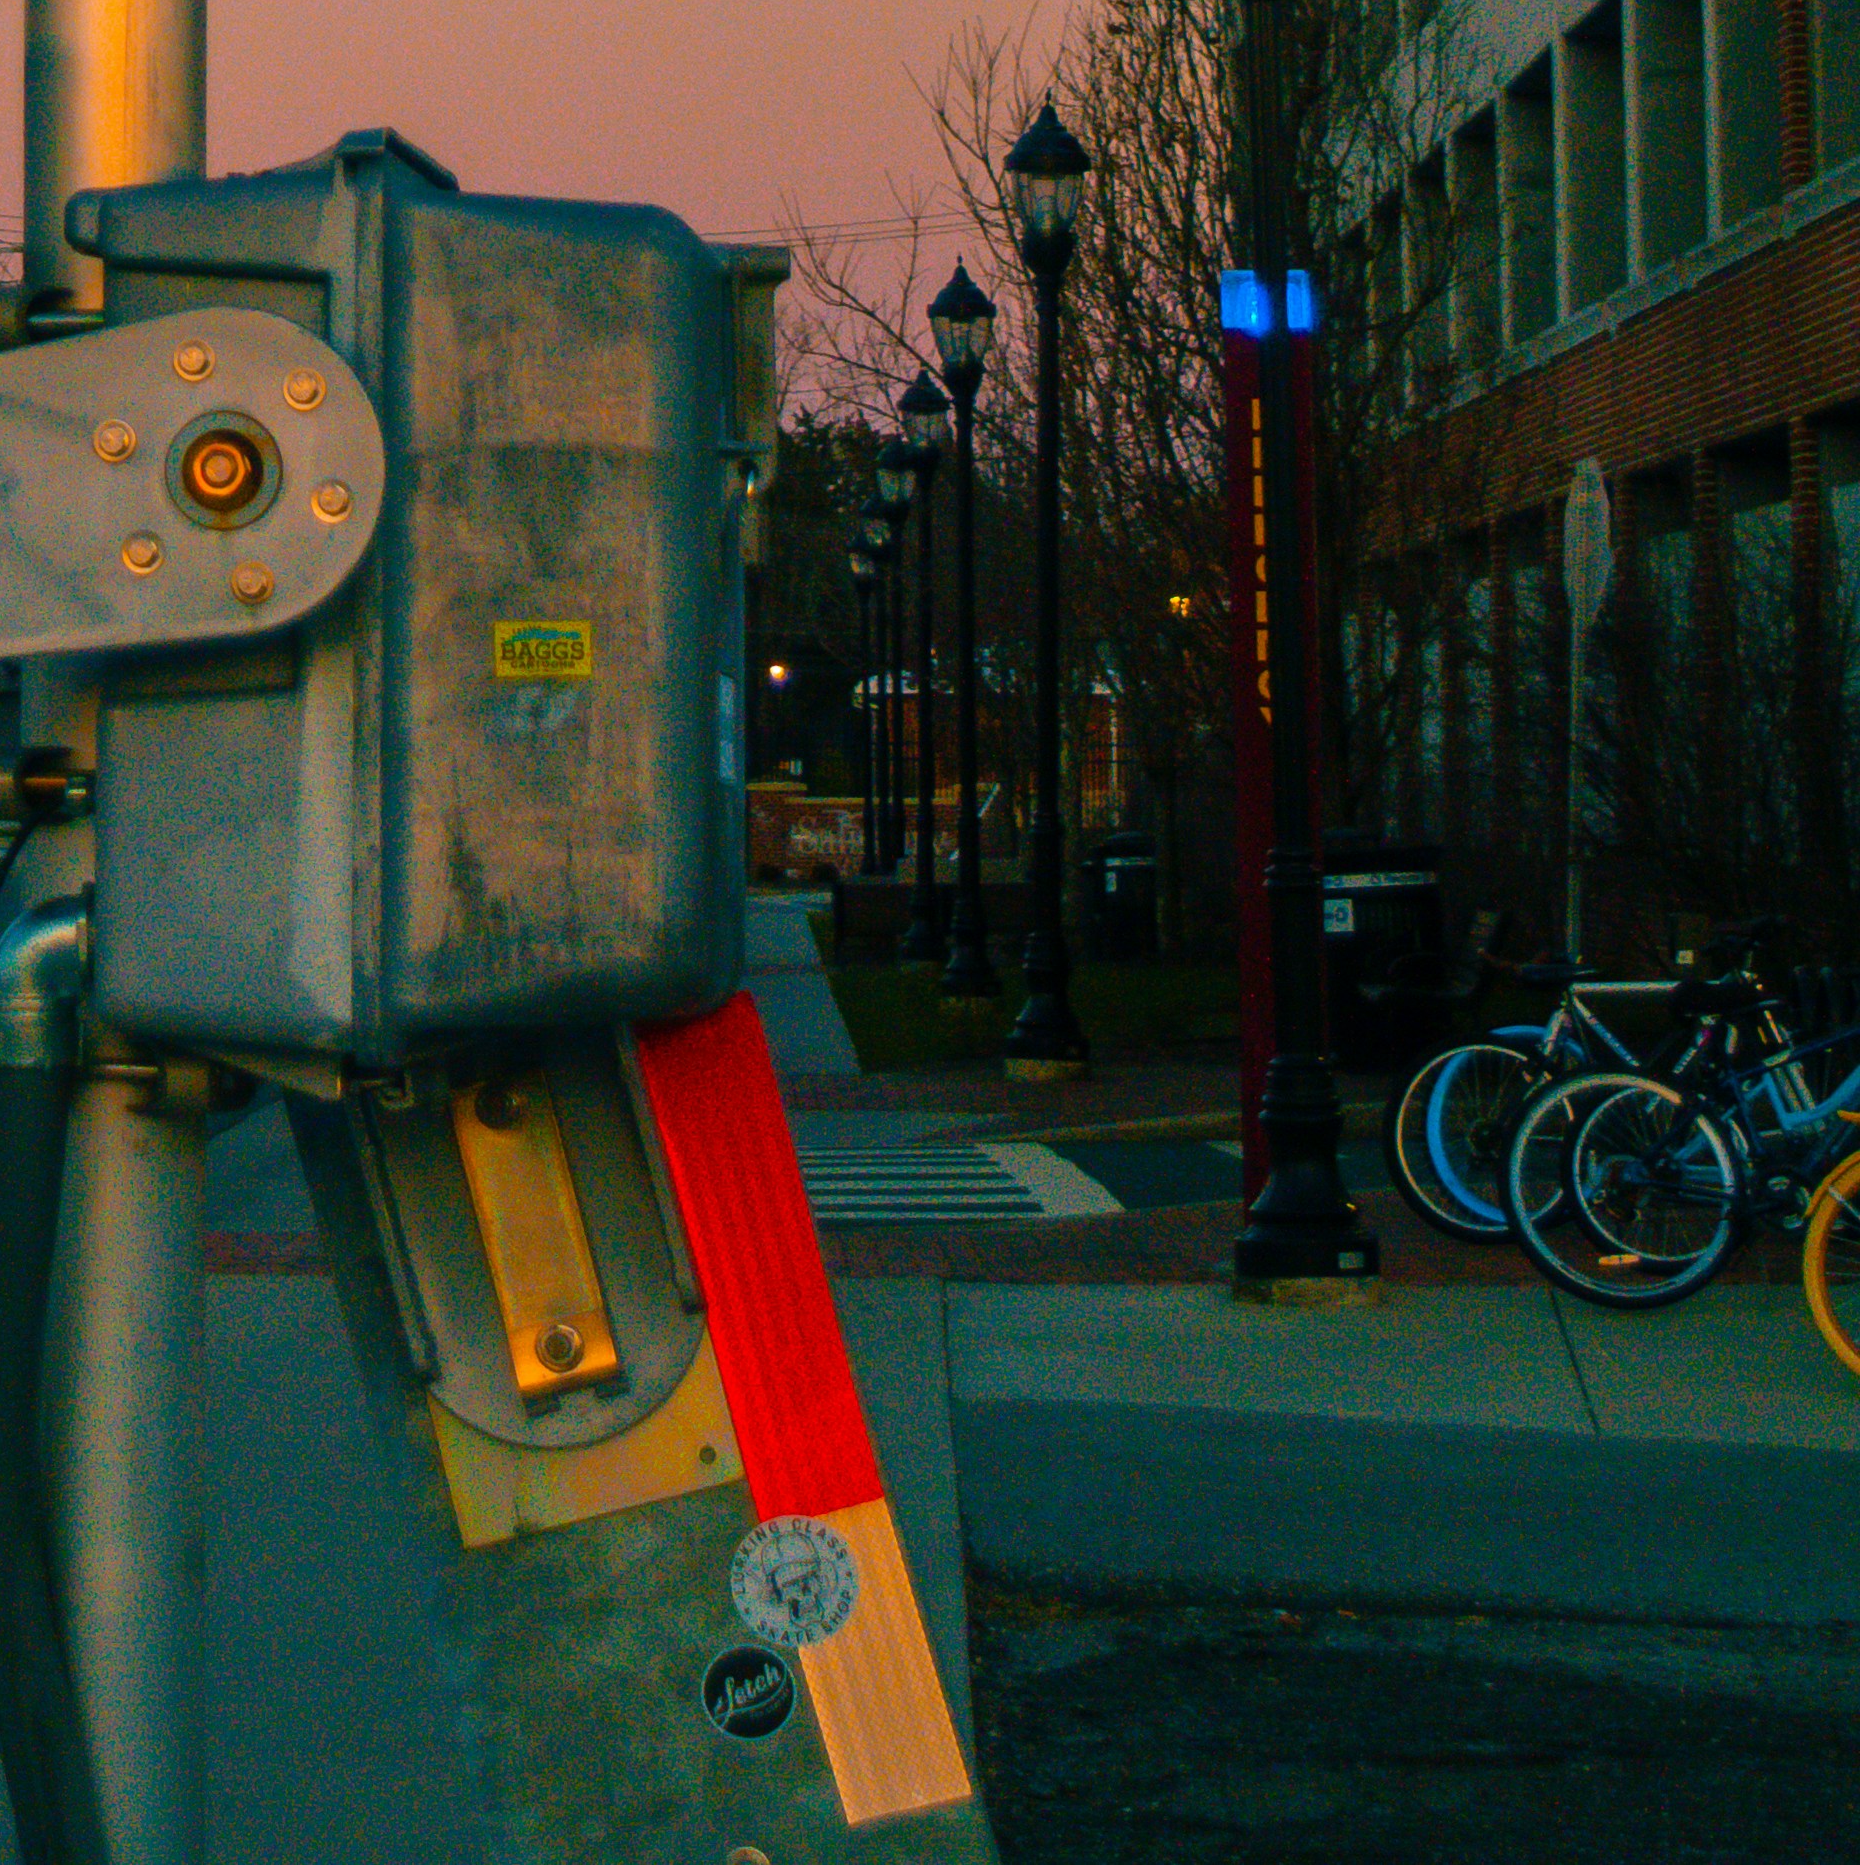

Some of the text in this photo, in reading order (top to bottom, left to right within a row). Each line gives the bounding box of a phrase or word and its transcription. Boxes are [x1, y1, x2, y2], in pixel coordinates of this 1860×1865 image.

[501, 641, 585, 660] BAGGS
[733, 1518, 848, 1596] LURKING CLASS
[756, 1589, 853, 1644] SKATE SHOP
